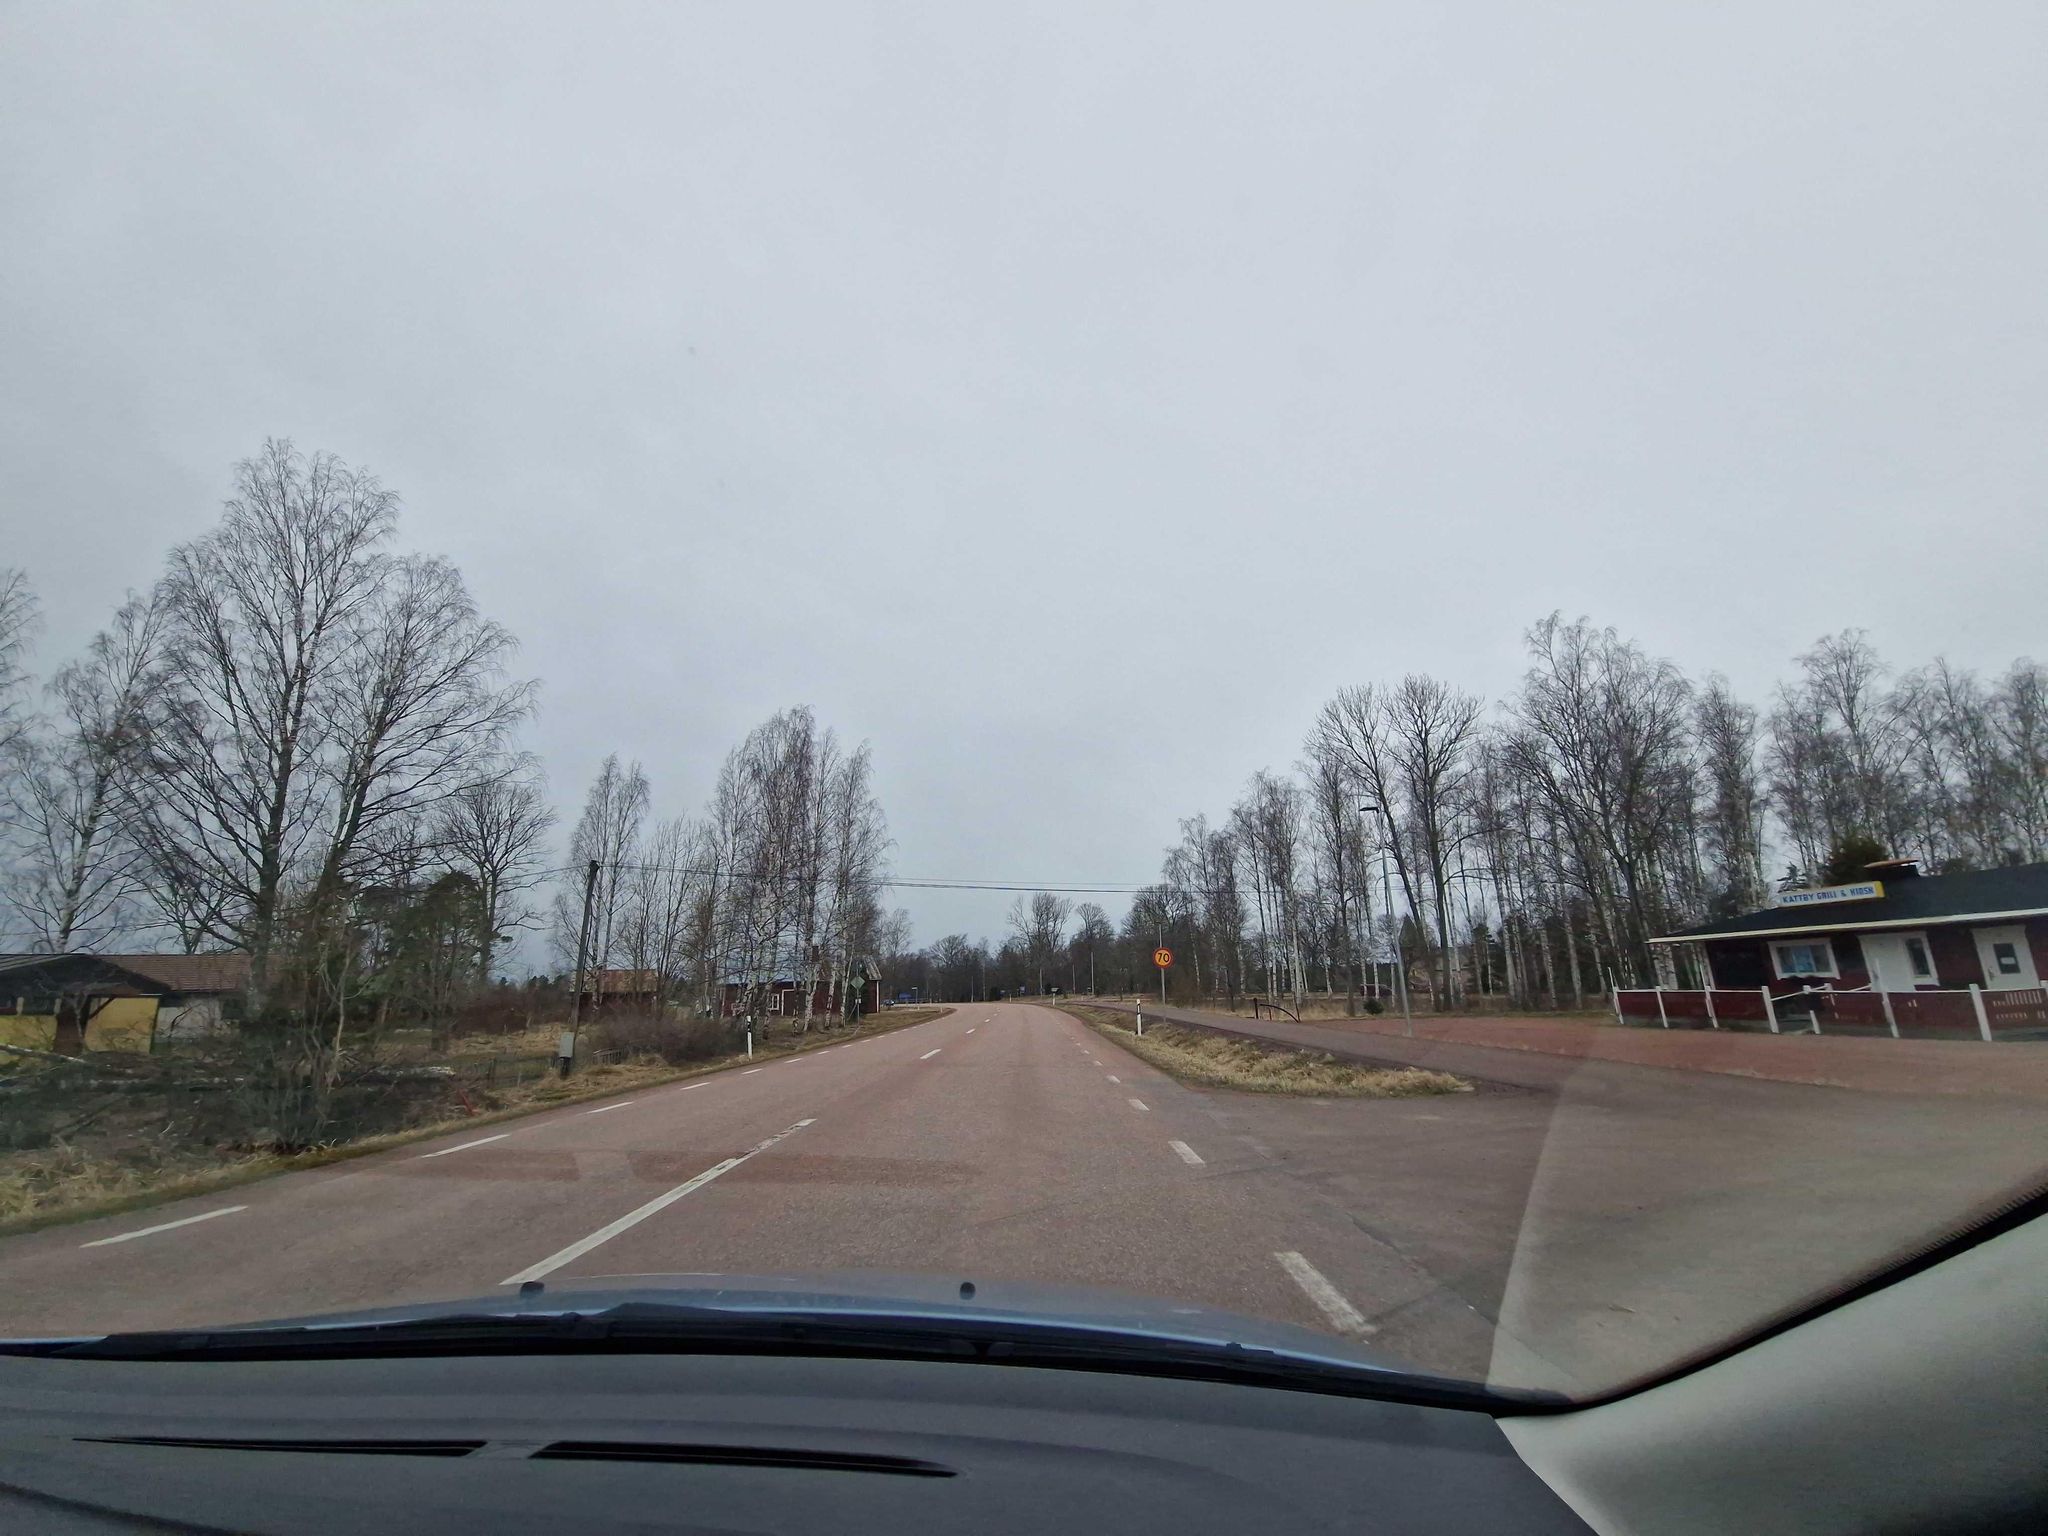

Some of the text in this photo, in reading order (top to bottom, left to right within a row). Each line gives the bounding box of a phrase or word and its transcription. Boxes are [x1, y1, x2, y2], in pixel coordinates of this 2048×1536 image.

[1782, 886, 1875, 904] KATTBY GRILL & KIOSK
[1157, 952, 1170, 963] 70
